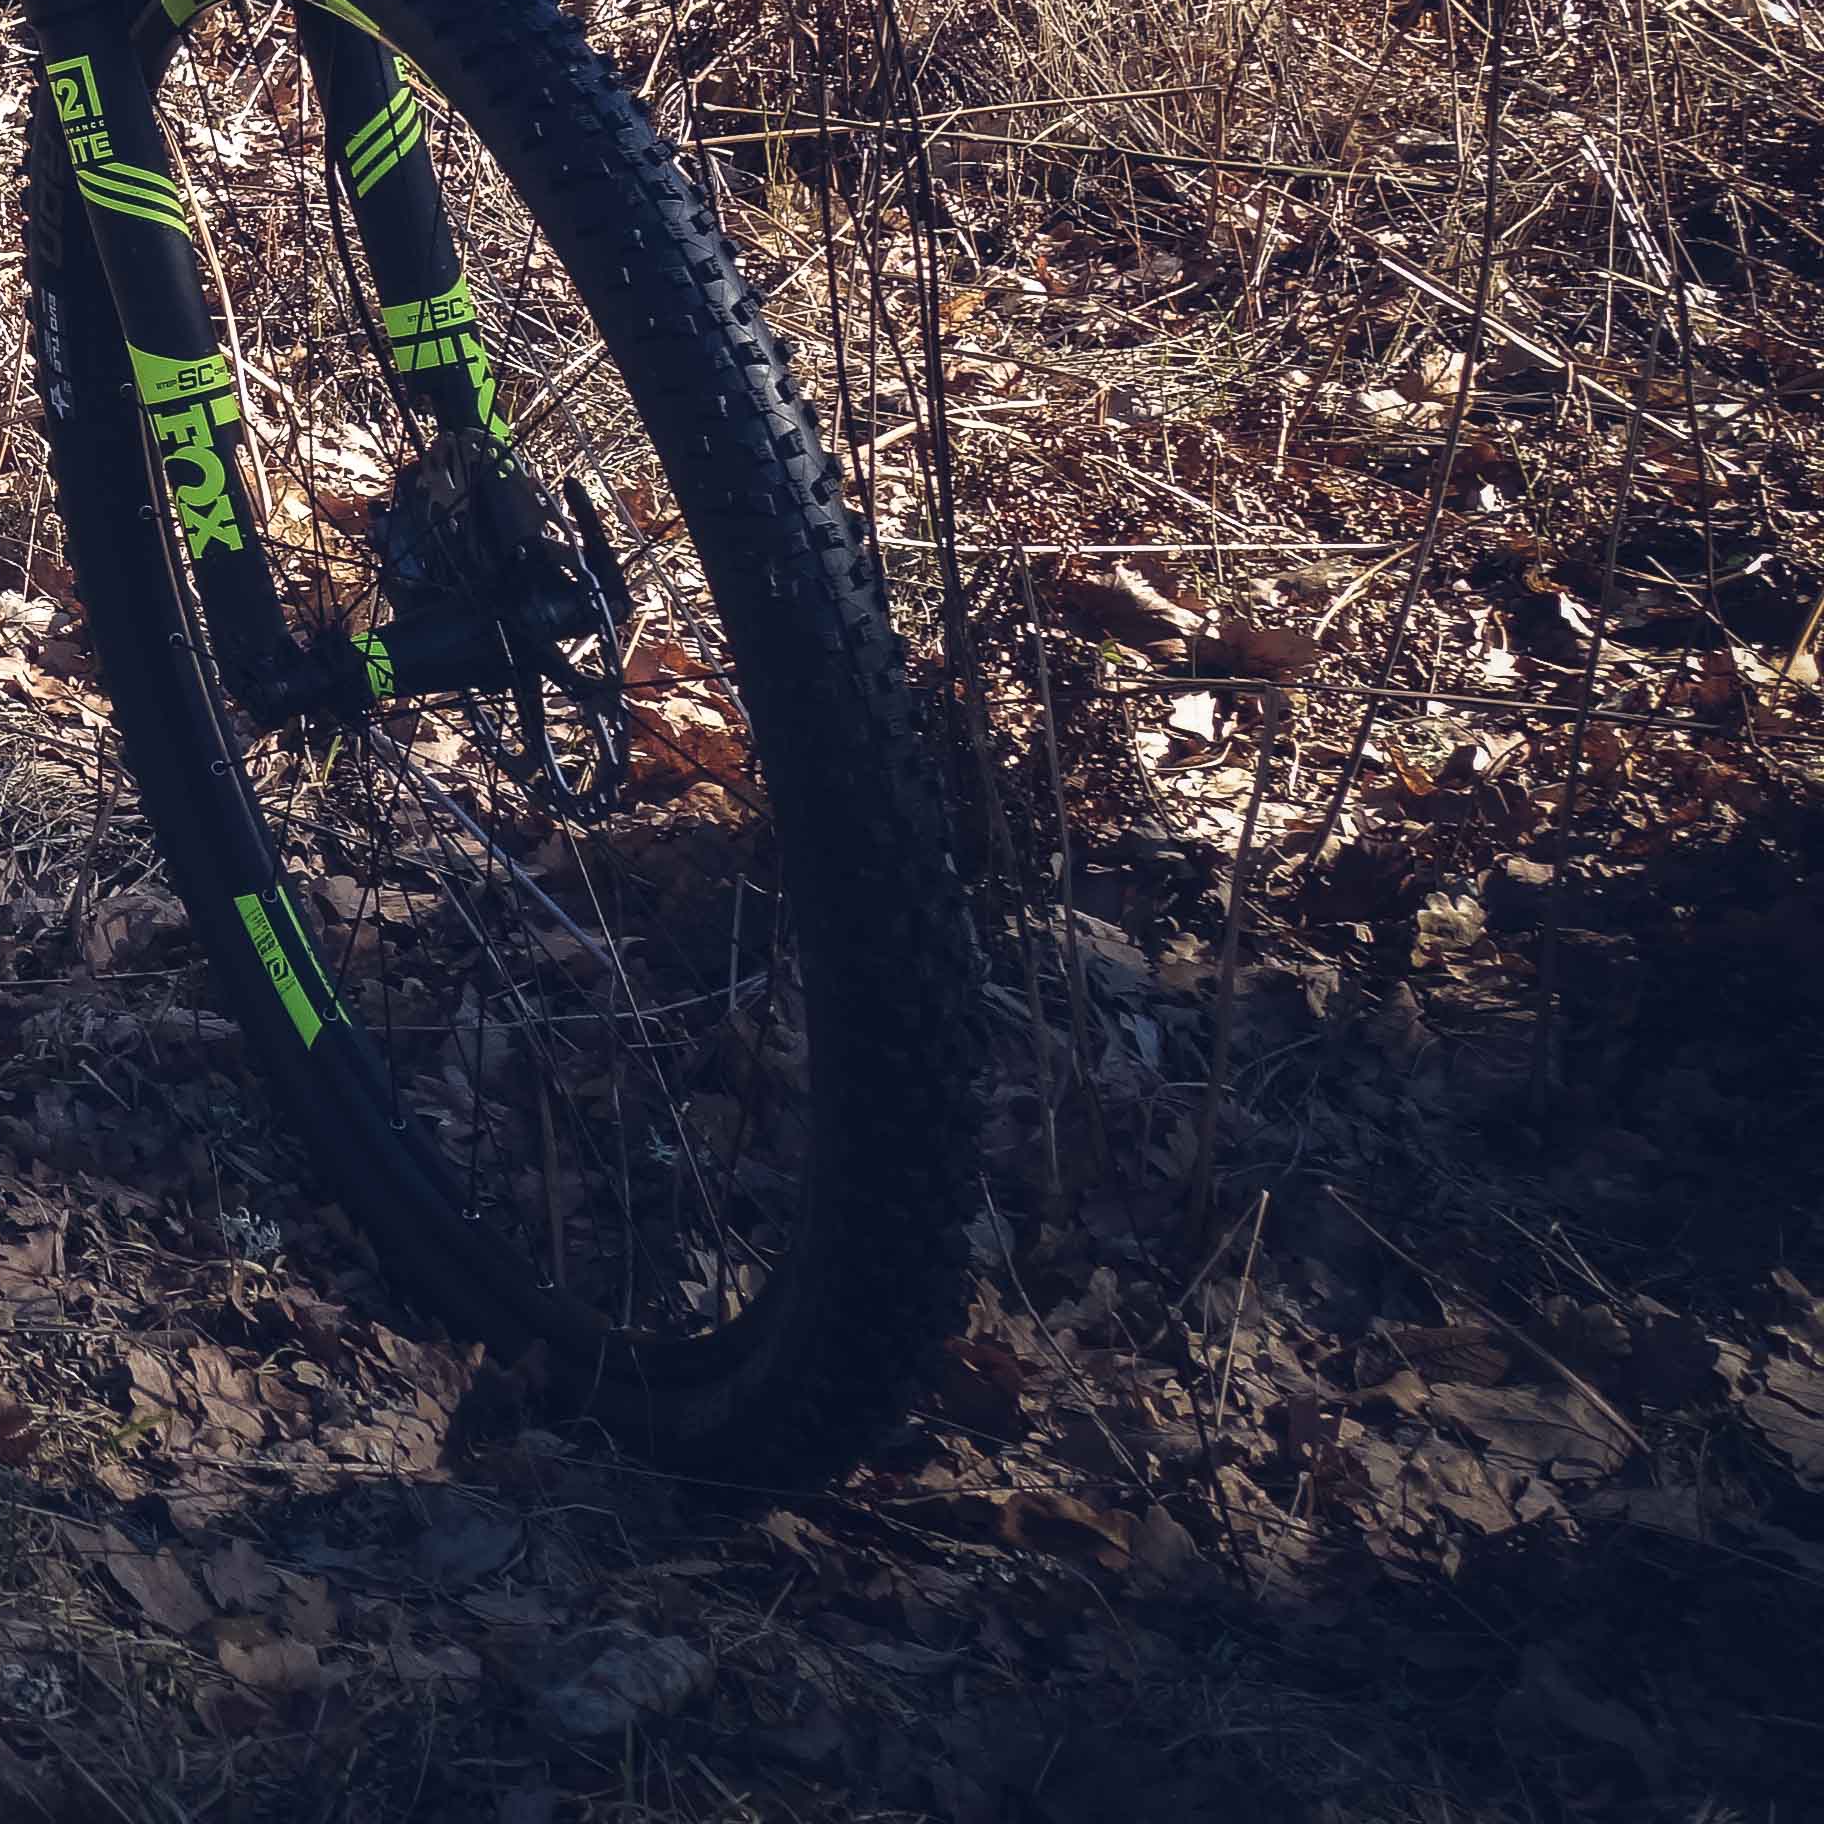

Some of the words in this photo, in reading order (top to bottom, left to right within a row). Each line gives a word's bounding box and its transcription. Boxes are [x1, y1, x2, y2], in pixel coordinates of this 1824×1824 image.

[68, 131, 114, 165] ITE
[431, 297, 465, 323] SC
[177, 363, 215, 391] SC
[154, 402, 244, 560] FOX
